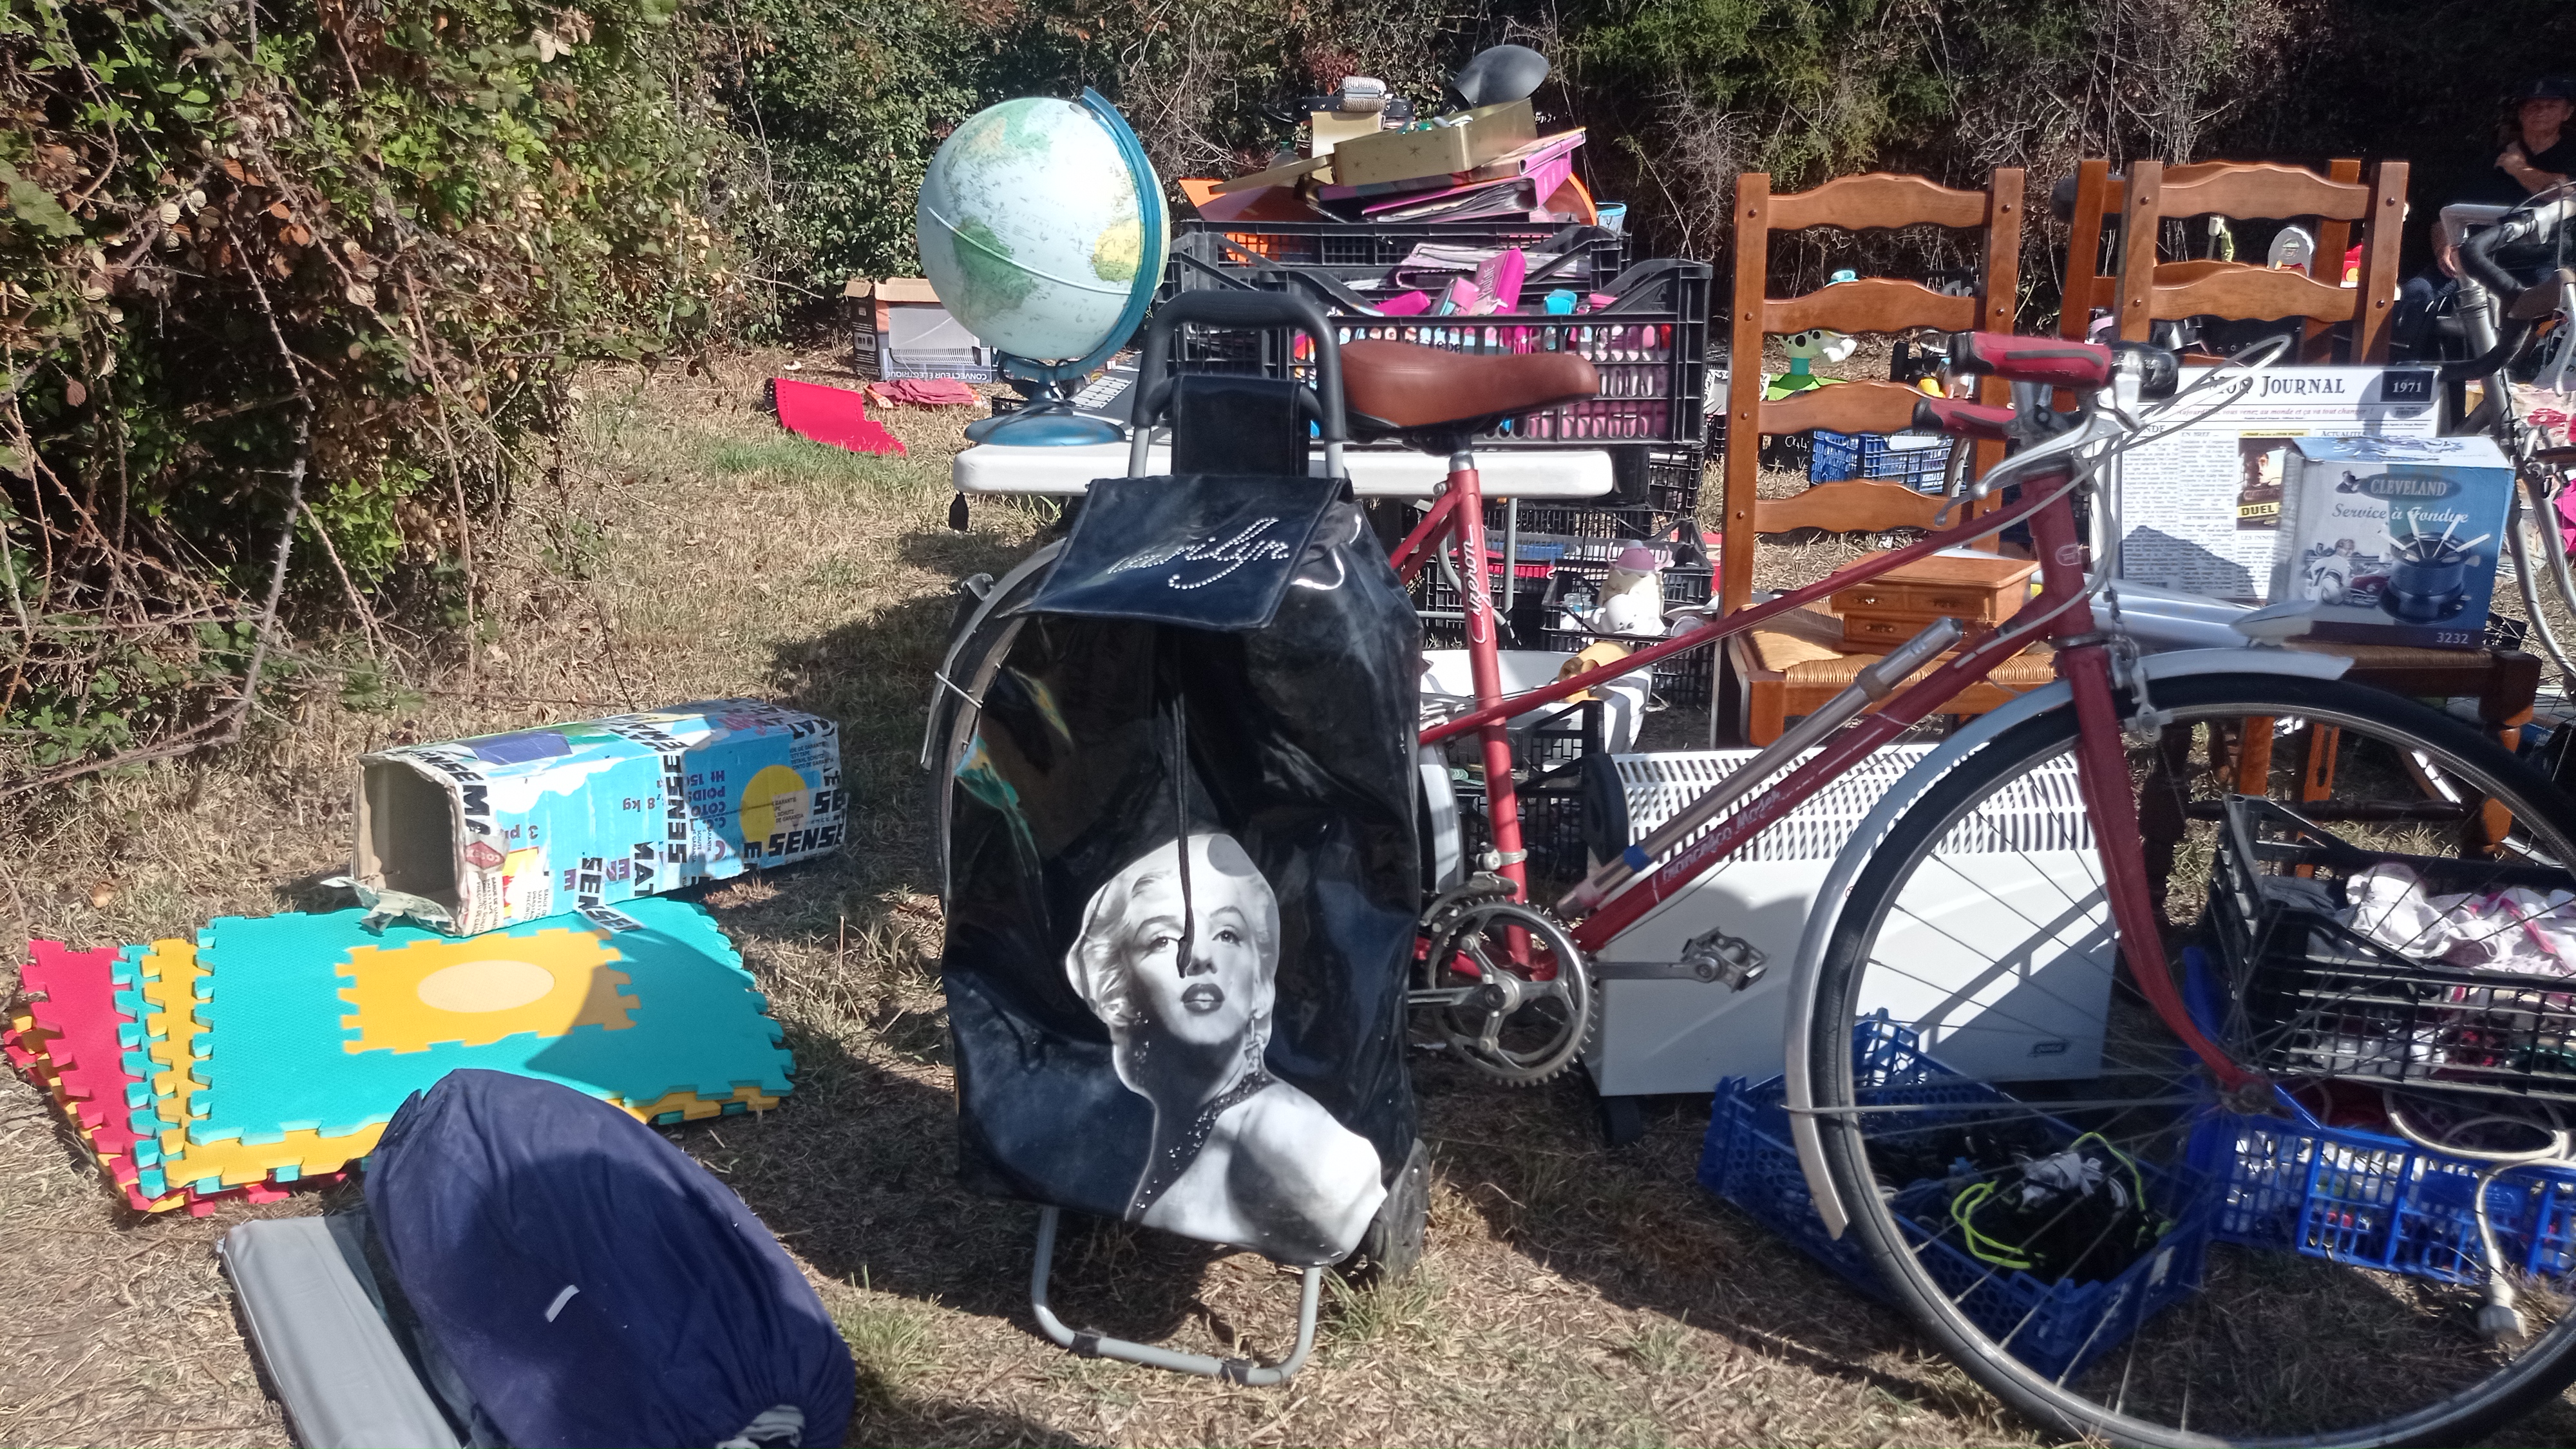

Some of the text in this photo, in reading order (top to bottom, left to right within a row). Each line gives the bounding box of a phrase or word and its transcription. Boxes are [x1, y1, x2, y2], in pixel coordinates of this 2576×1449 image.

[935, 372, 987, 381] CONVECTEUR
[2259, 376, 2345, 398] JOURNAL
[2393, 382, 2421, 393] 1971
[2370, 480, 2448, 497] CLEVELAND
[2241, 505, 2275, 515] DUEL
[2331, 503, 2386, 520] Service
[2391, 507, 2403, 520] à
[2436, 632, 2469, 644] 3232
[623, 797, 641, 812] kg
[527, 824, 538, 839] 3
